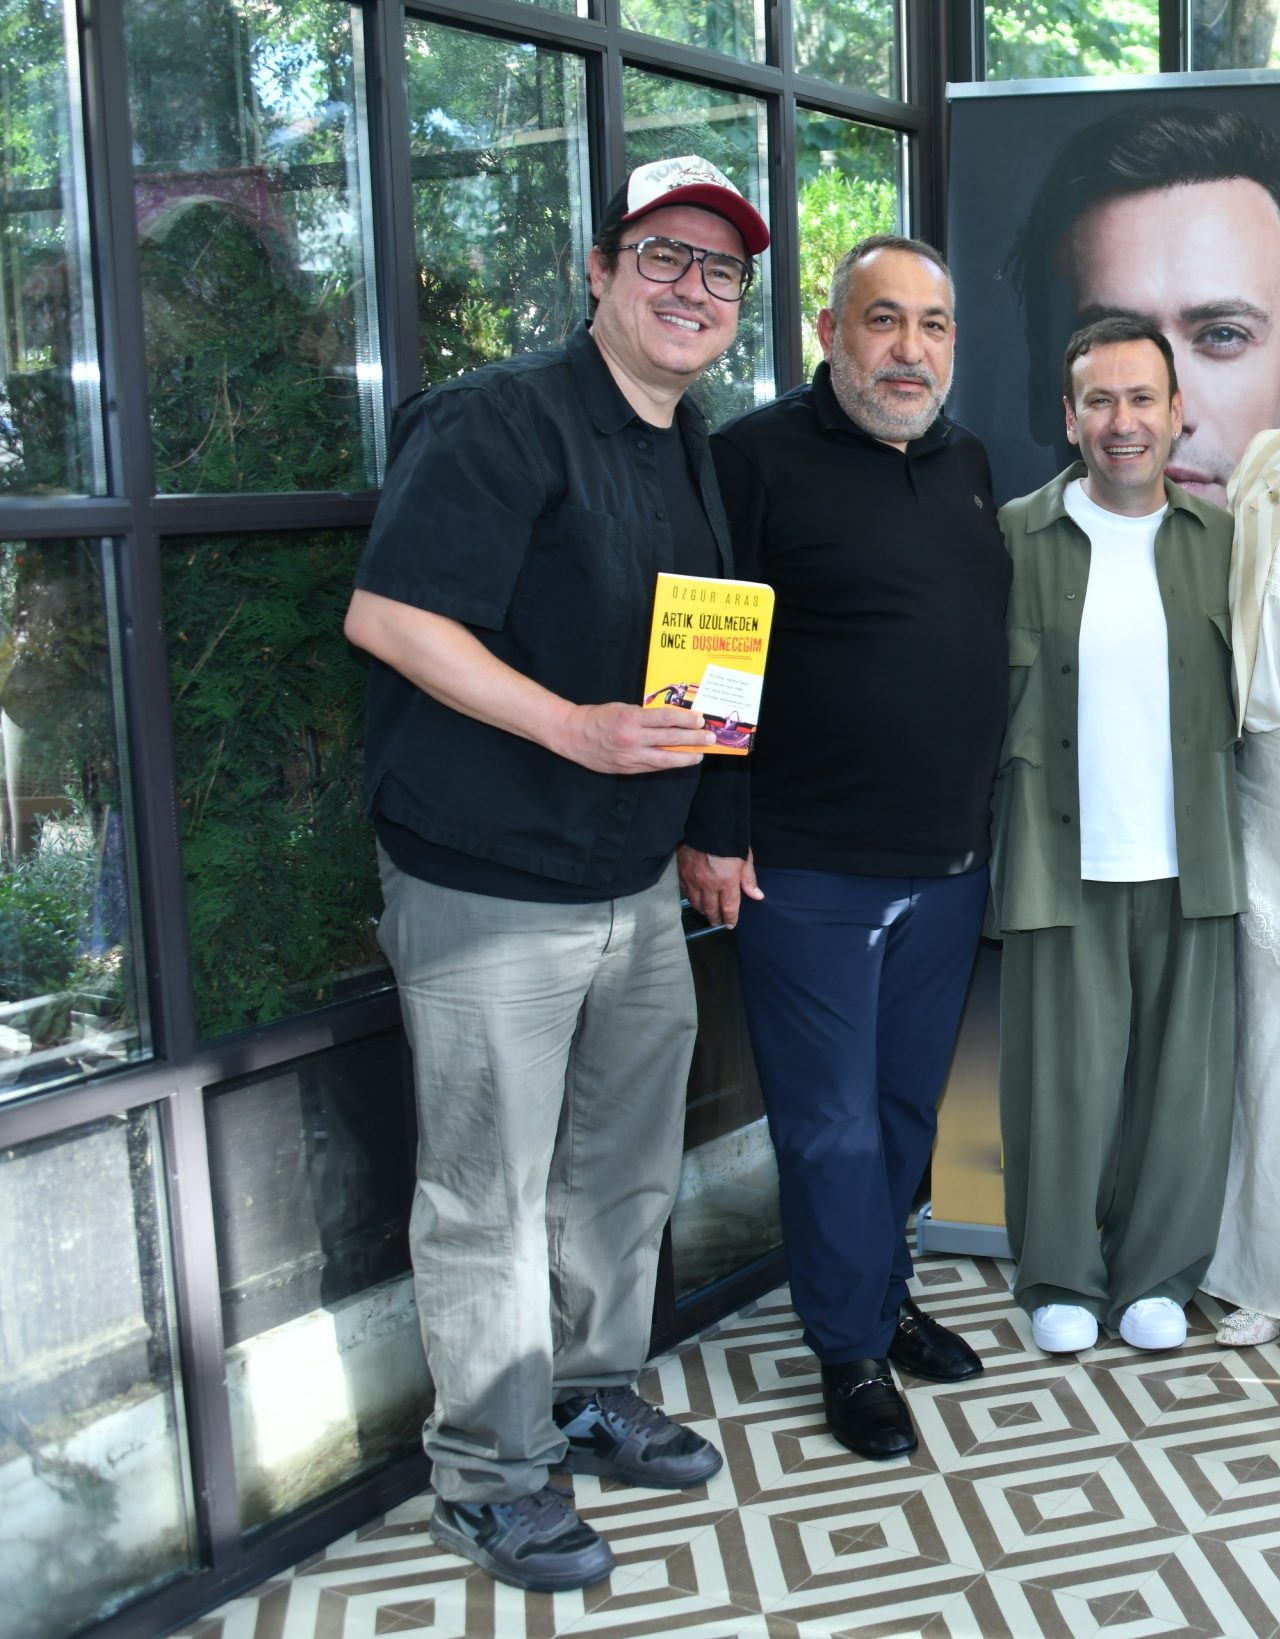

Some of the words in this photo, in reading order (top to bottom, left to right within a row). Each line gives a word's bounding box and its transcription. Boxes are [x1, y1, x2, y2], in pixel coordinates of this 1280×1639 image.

[672, 584, 716, 603] ÖZGÜR
[724, 593, 760, 608] ARAS
[662, 611, 694, 629] ARTIK
[699, 612, 760, 632] ÜZÜLMEDEN
[660, 630, 687, 650] ÖNCE
[692, 633, 763, 653] DÜŞÜNECEĞİM
